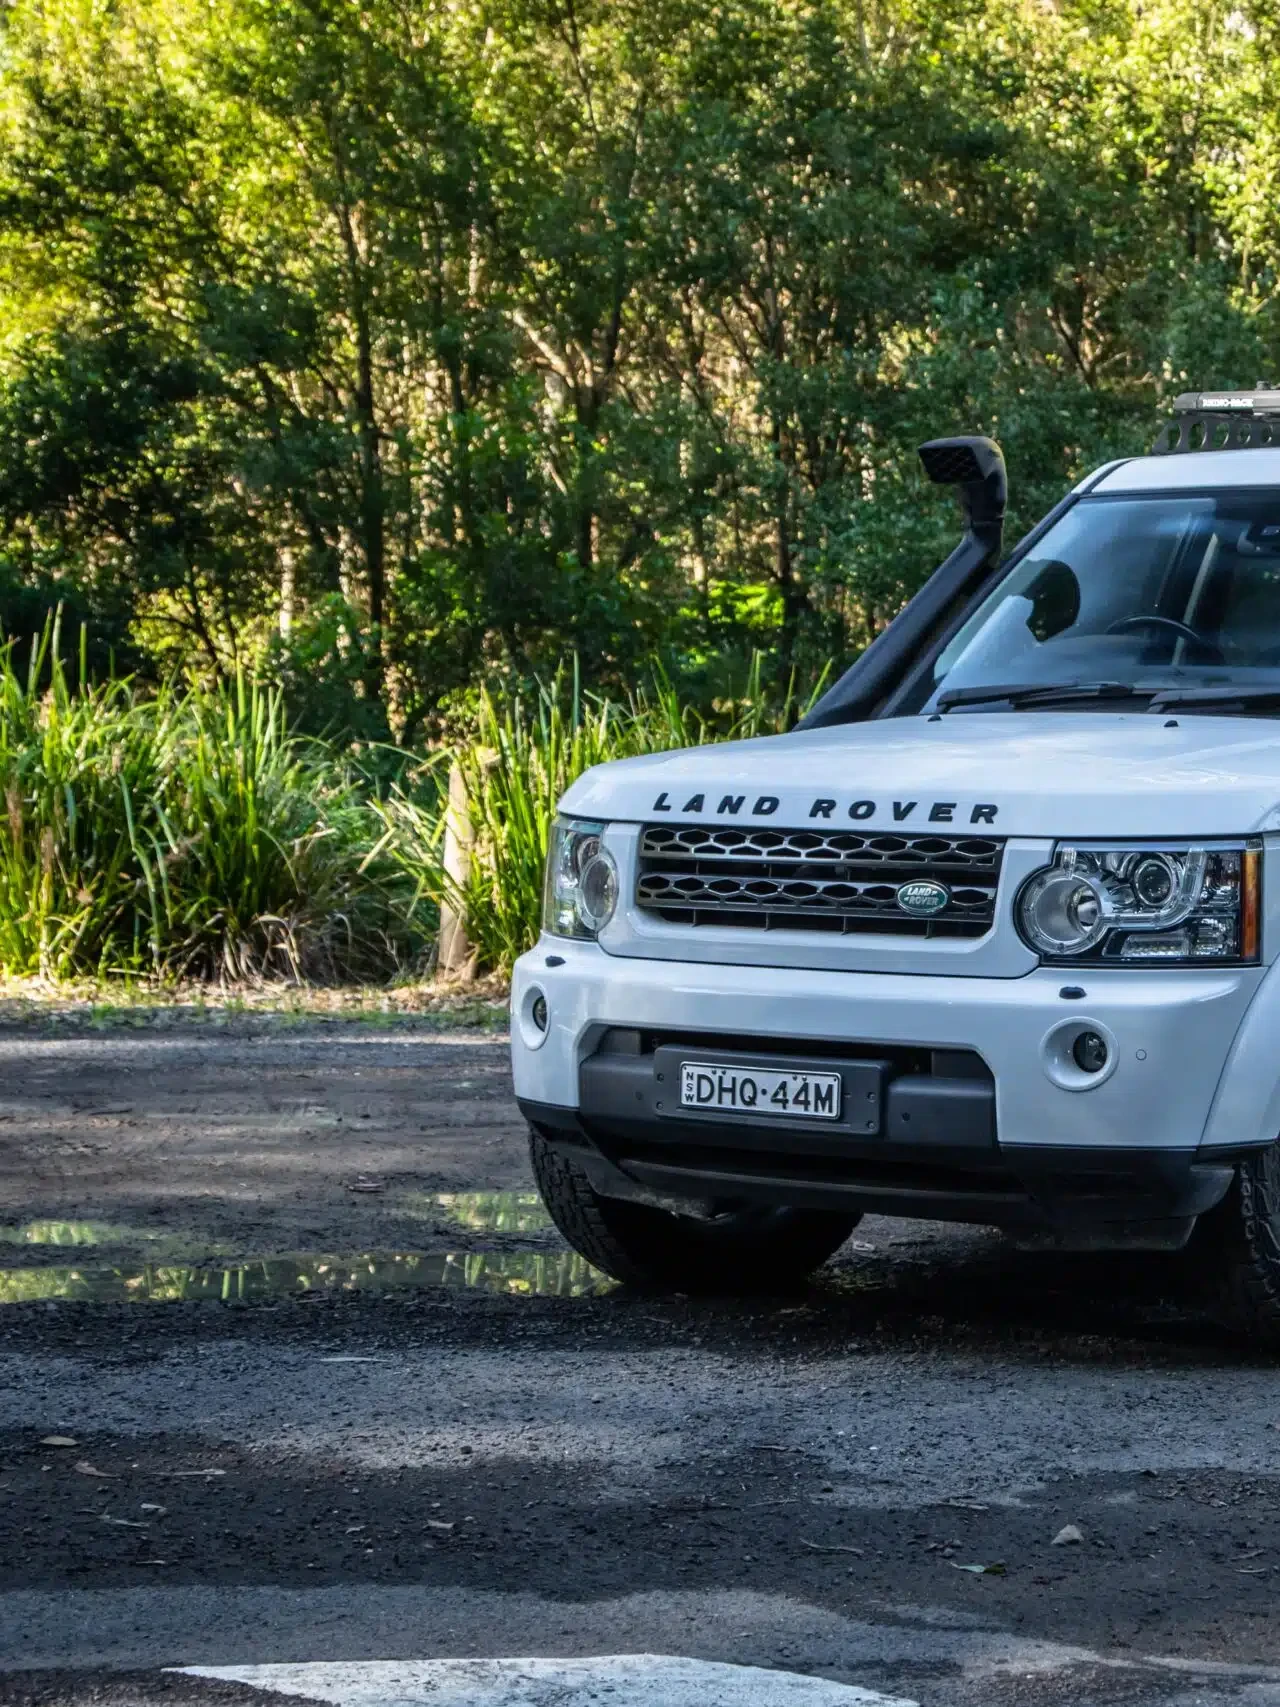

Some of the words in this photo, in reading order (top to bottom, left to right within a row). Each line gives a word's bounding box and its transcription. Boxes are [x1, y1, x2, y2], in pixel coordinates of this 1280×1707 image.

[653, 792, 781, 815] LAND
[808, 798, 999, 824] ROVER
[907, 887, 931, 896] LAND
[909, 896, 939, 906] ROVER
